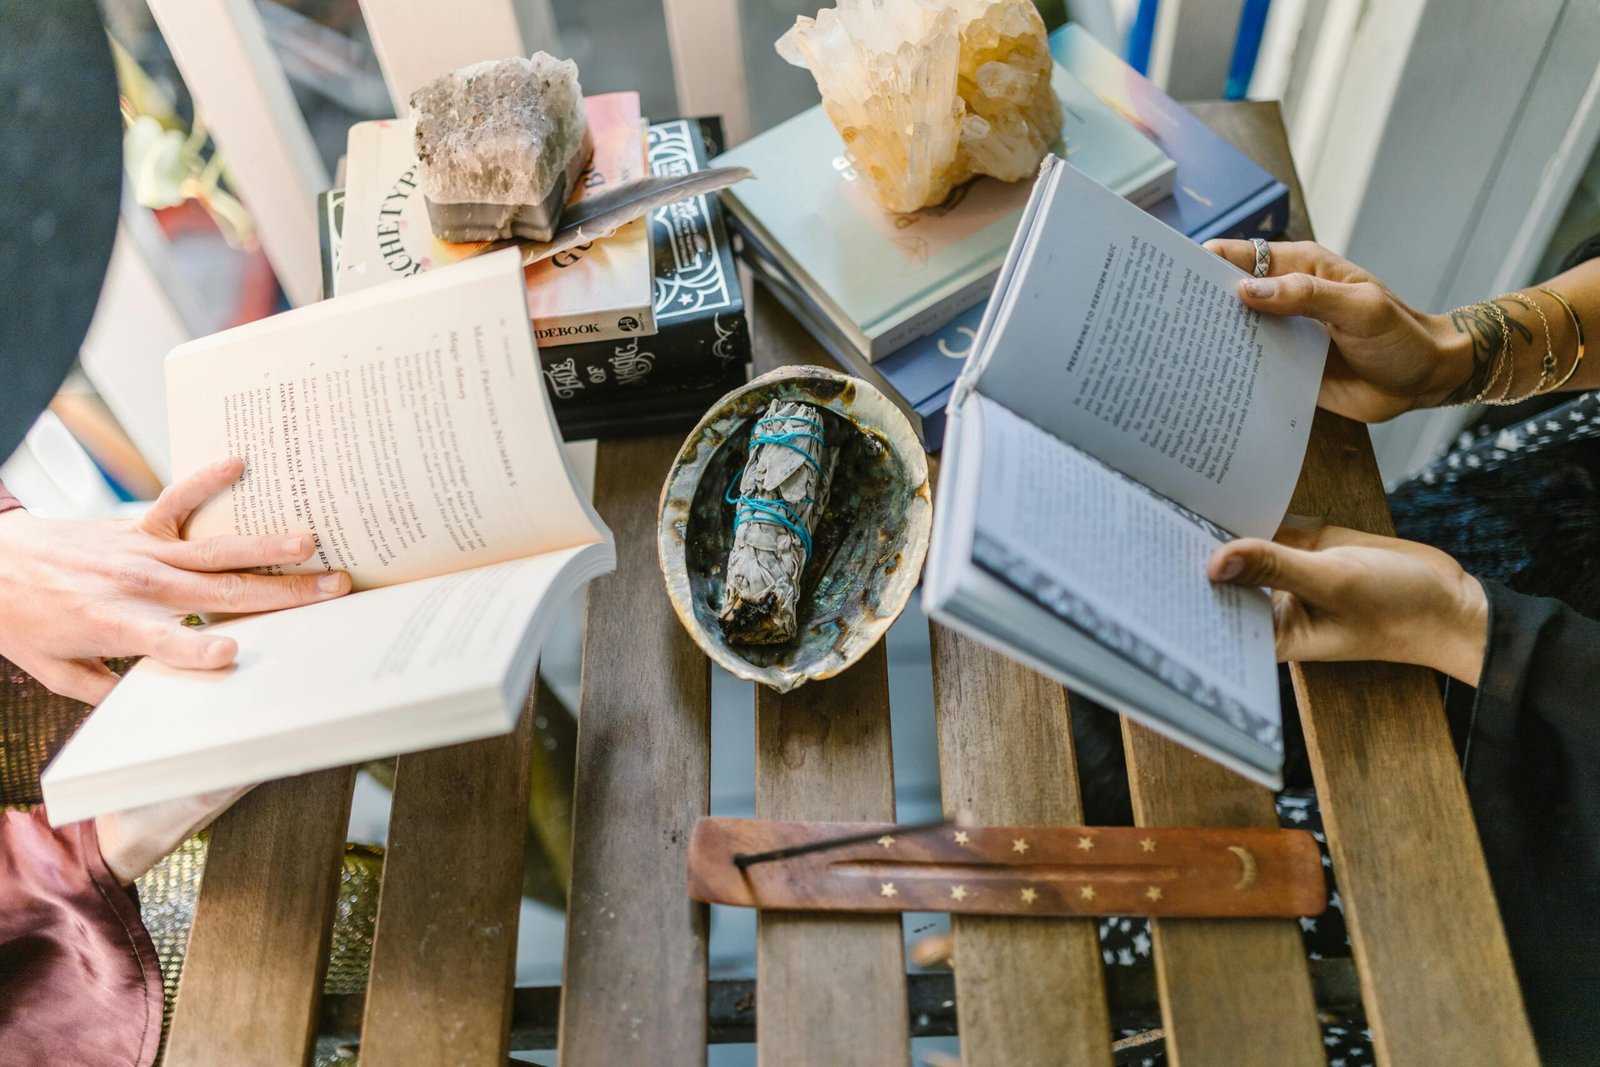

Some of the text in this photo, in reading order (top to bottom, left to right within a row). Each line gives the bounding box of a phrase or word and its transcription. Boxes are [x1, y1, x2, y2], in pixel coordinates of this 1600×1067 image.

[377, 164, 421, 278] CHETYP
[1066, 325, 1089, 372] PREPARING
[1090, 271, 1107, 309] PERFORM
[1104, 244, 1116, 270] MAGIC
[533, 323, 600, 339] IDEBOOK
[1217, 329, 1226, 354] stomach
[1240, 328, 1248, 341] with
[1212, 355, 1220, 371] your
[1234, 344, 1244, 359] body
[543, 357, 585, 399] TALE
[586, 365, 606, 384] OF
[1168, 429, 1186, 459] thoughts
[1190, 392, 1198, 409] your
[1200, 356, 1210, 371] Tune
[1217, 291, 1226, 308] Focus
[1206, 371, 1216, 388] allow
[229, 393, 237, 411] your
[1203, 389, 1211, 402] and
[1222, 377, 1236, 403] flooding
[246, 390, 255, 431] afternoon,
[1193, 428, 1208, 454] Imagine
[1205, 412, 1214, 426] that
[1211, 398, 1219, 411] you
[1218, 355, 1232, 384] breathing
[1215, 405, 1227, 425] breath
[1230, 437, 1239, 451] you
[1239, 407, 1248, 425] ready
[1246, 374, 1256, 400] perform
[234, 413, 242, 440] written
[1189, 404, 1207, 435] breathing
[1205, 464, 1216, 479] light
[1212, 446, 1224, 463] from
[1220, 433, 1228, 444] the
[1232, 392, 1241, 409] Once
[1240, 365, 1248, 378] feel
[1184, 436, 1194, 453] your
[1211, 428, 1220, 443] each
[235, 442, 245, 462] word
[242, 444, 251, 467] Magic
[250, 453, 260, 474] many
[1195, 445, 1213, 473] Visualize
[282, 414, 295, 481] THROUGHOUT
[293, 499, 302, 521] LIFE.
[244, 468, 253, 492] Dollar
[263, 463, 271, 497] morning
[238, 495, 247, 512] truly
[307, 440, 315, 459] place
[328, 529, 339, 546] bold
[268, 499, 276, 514] and
[325, 479, 335, 499] small
[330, 501, 338, 514] bill
[334, 516, 344, 530] and
[339, 532, 349, 550] write
[242, 513, 253, 536] gratef
[271, 516, 279, 535] once
[299, 478, 307, 496] THE
[304, 498, 316, 530] MONEY
[312, 533, 322, 549] I'VE
[318, 551, 333, 572] BEEN
